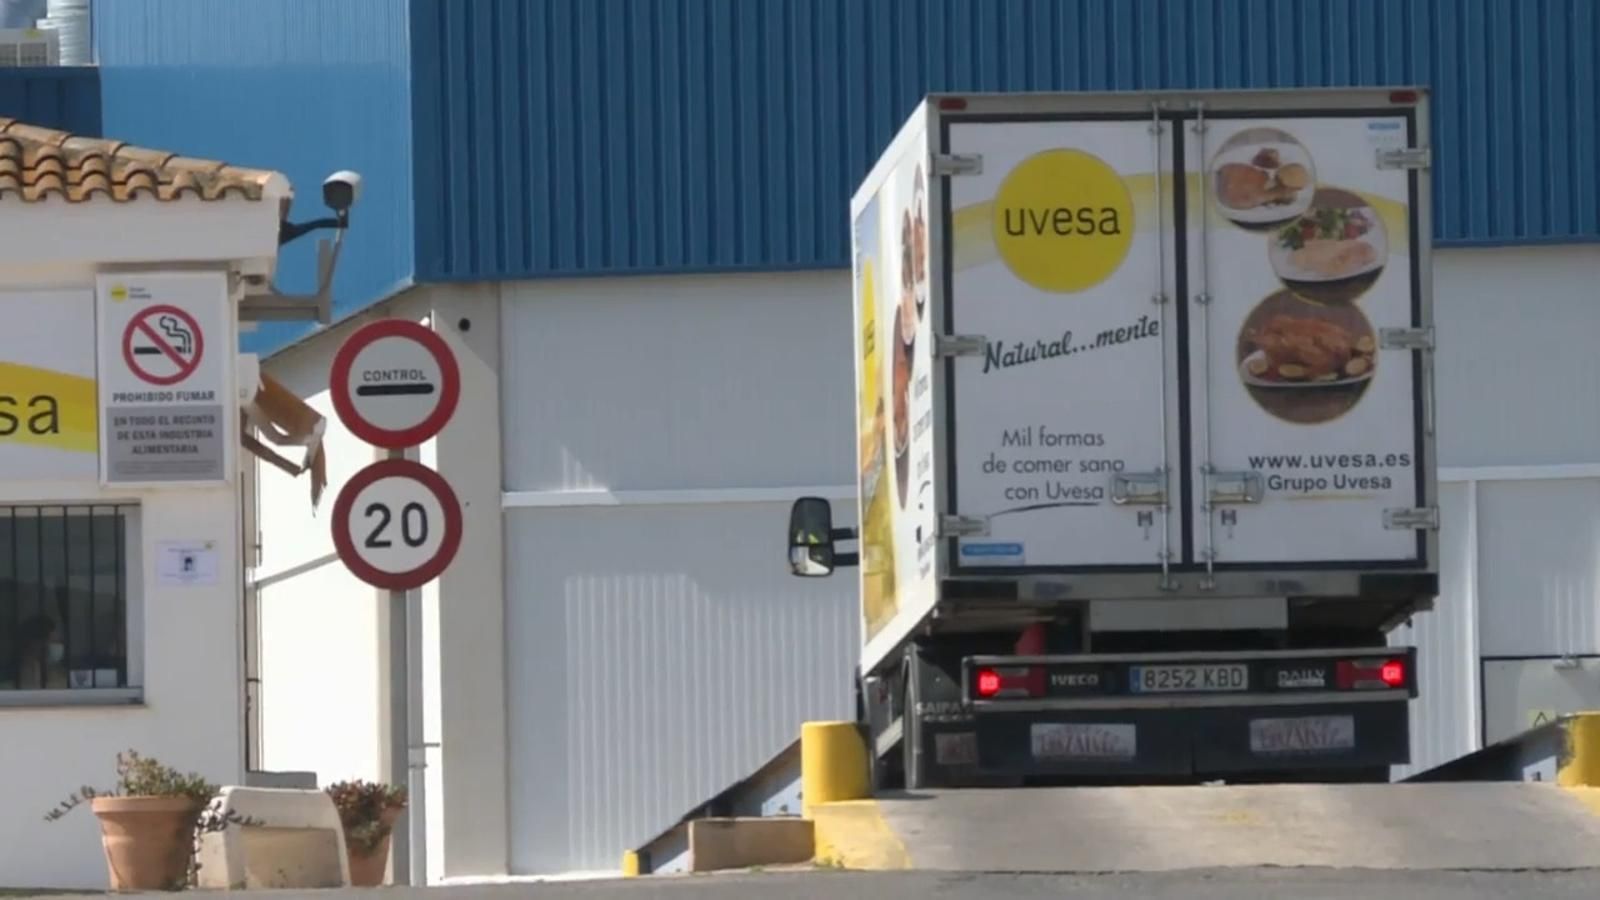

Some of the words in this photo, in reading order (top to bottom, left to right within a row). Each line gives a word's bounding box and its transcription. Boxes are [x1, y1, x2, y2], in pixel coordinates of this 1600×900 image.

[1004, 206, 1121, 236] uvesa
[982, 314, 1160, 375] Natural...mente
[362, 368, 427, 382] CONTROL
[112, 390, 173, 402] PROHIBIDO
[176, 389, 215, 401] FUMAR
[114, 415, 127, 427] EN
[129, 415, 156, 426] TODO
[158, 415, 171, 426] EL
[172, 414, 215, 425] RECINTO
[117, 431, 129, 441] DE
[132, 430, 156, 440] ESTA
[159, 428, 214, 440] INDUSTRIA
[1001, 427, 1033, 448] Mil
[1038, 424, 1105, 447] formas
[131, 444, 199, 455] ALIMENTARIA
[981, 452, 1007, 474] de
[1012, 459, 1072, 473] comer
[1079, 458, 1125, 473] sano
[1248, 453, 1411, 470] www.uvesa.es
[1004, 485, 1039, 500] con
[1045, 481, 1104, 500] Uvesa
[1267, 474, 1328, 493] Grupo
[1333, 473, 1392, 491] Uvesa
[364, 501, 429, 549] 20
[1051, 674, 1098, 686] IVECO
[1143, 669, 1197, 689] 8252
[1203, 667, 1243, 688] KBD
[1277, 670, 1326, 682] DAILY
